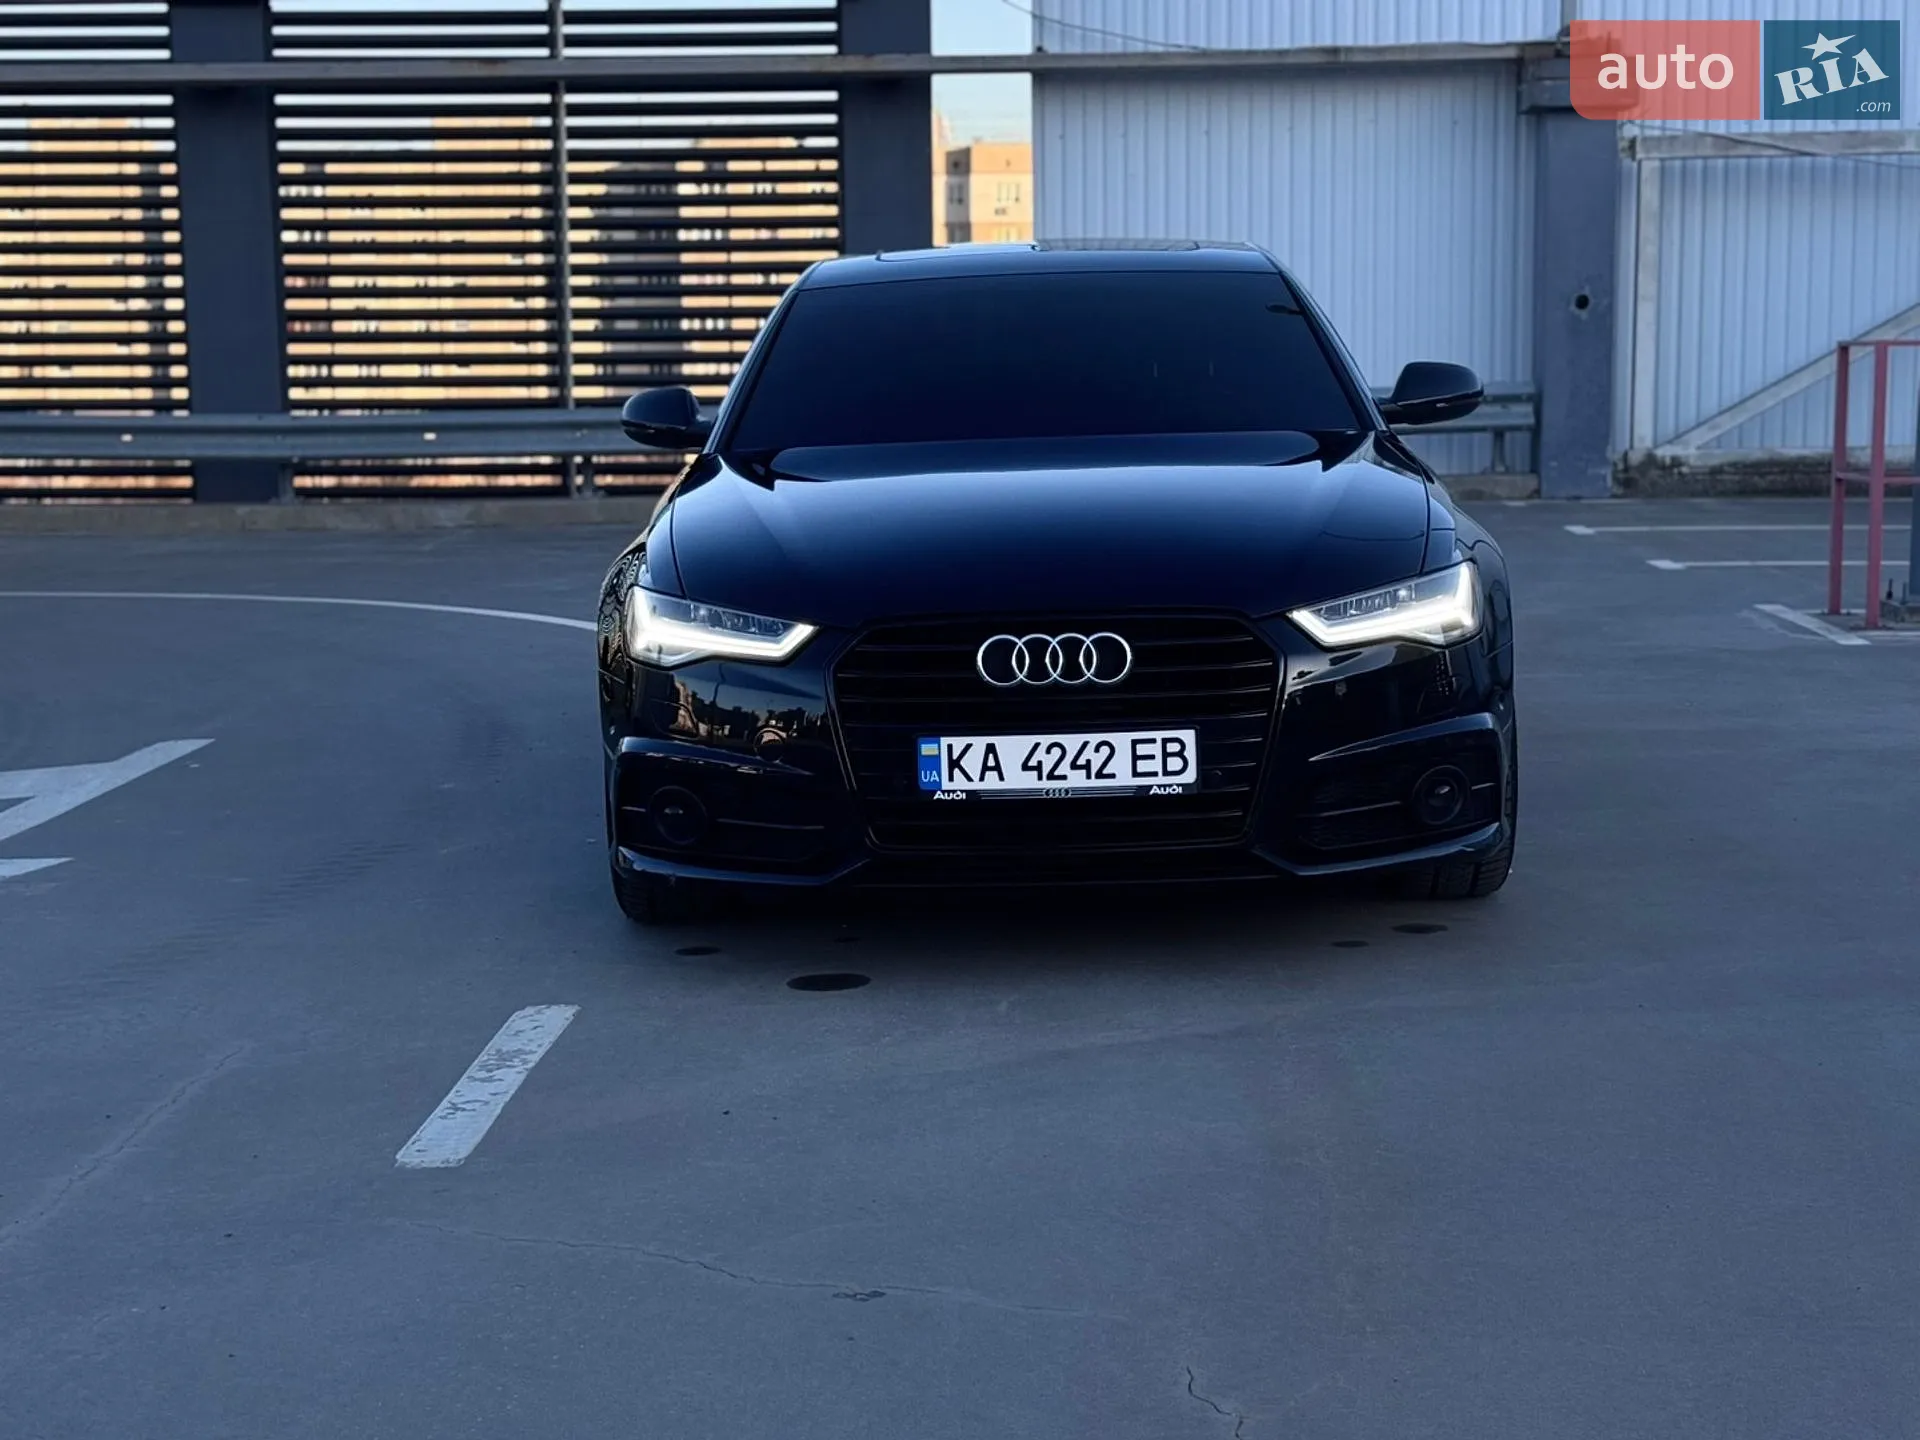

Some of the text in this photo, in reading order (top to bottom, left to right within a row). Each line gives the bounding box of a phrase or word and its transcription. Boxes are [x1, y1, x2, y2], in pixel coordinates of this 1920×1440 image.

[946, 737, 1189, 783] KA 4242 EB
[921, 770, 940, 783] UA
